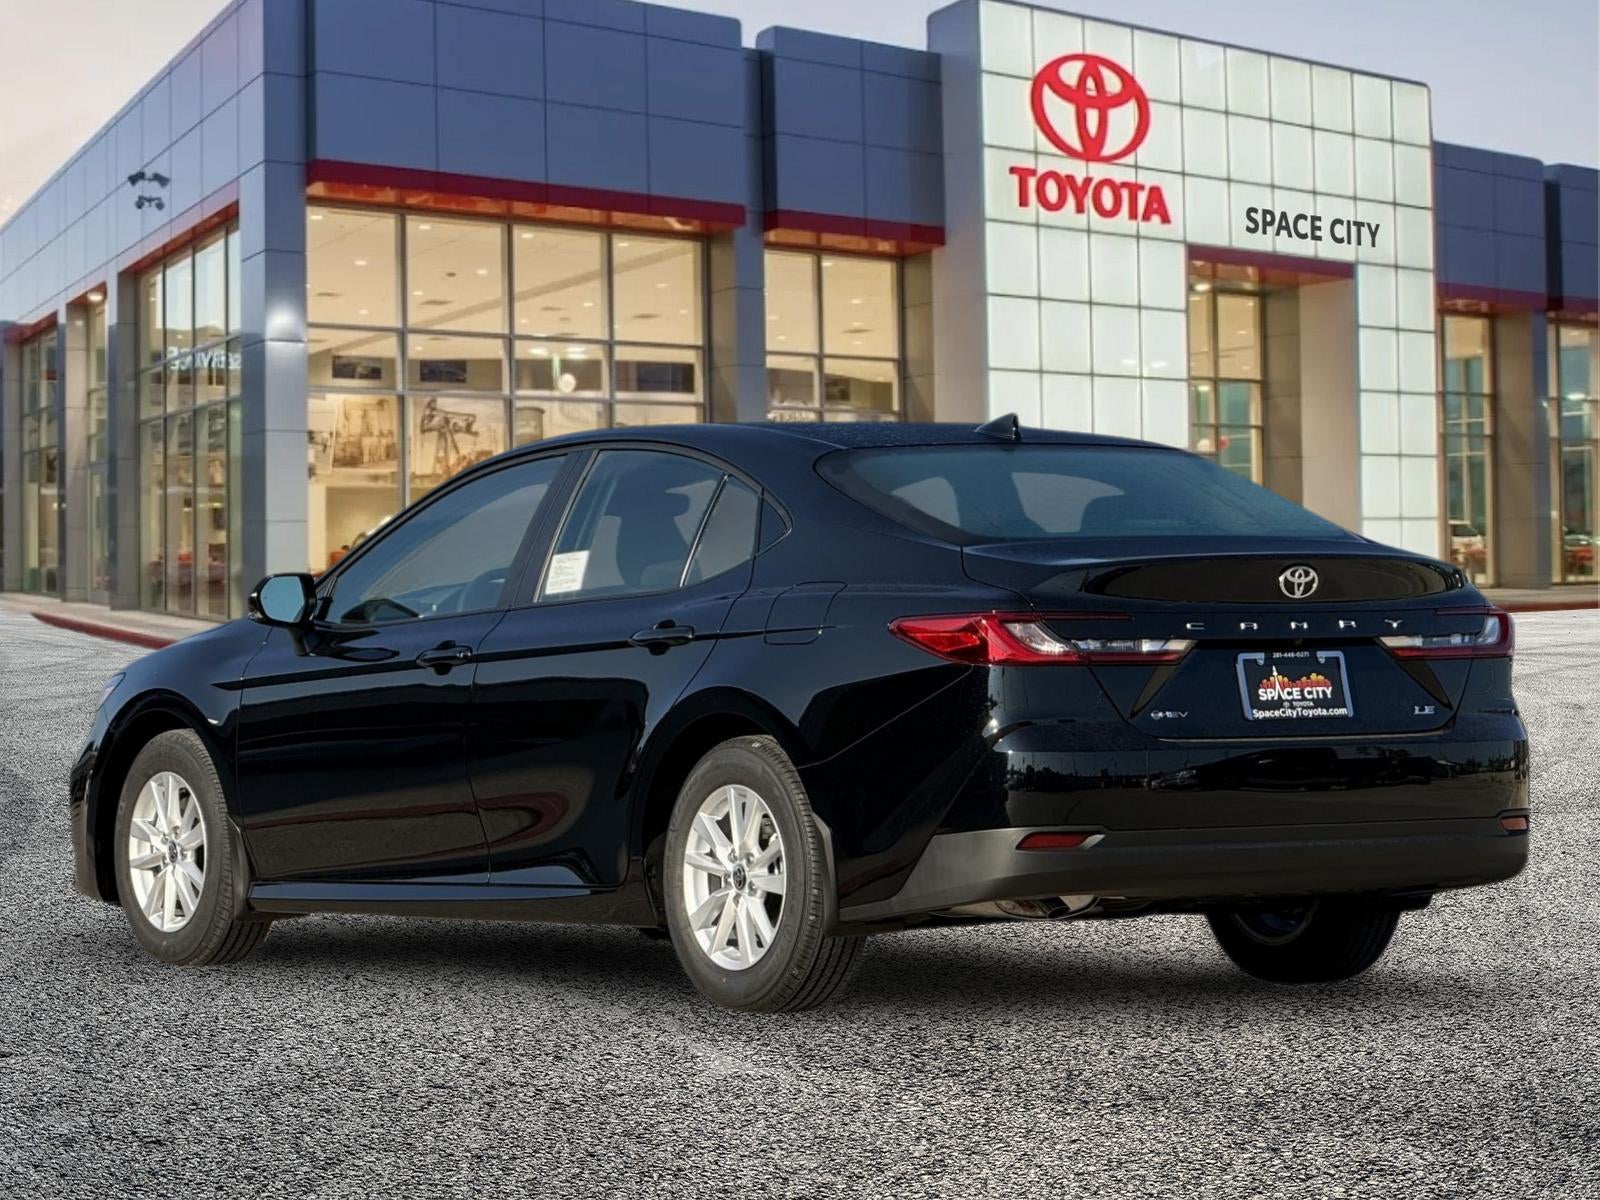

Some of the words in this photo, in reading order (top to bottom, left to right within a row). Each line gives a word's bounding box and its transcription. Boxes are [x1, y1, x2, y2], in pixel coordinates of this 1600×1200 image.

[1008, 166, 1171, 225] TOYOTA
[1245, 206, 1323, 241] SPACE
[1329, 218, 1381, 248] CITY
[1186, 619, 1403, 630] CAMRY
[1257, 686, 1302, 701] SPACE
[1303, 686, 1333, 700] CITY
[1252, 707, 1348, 719] SpaceCityToyota.com
[1414, 705, 1435, 715] LE
